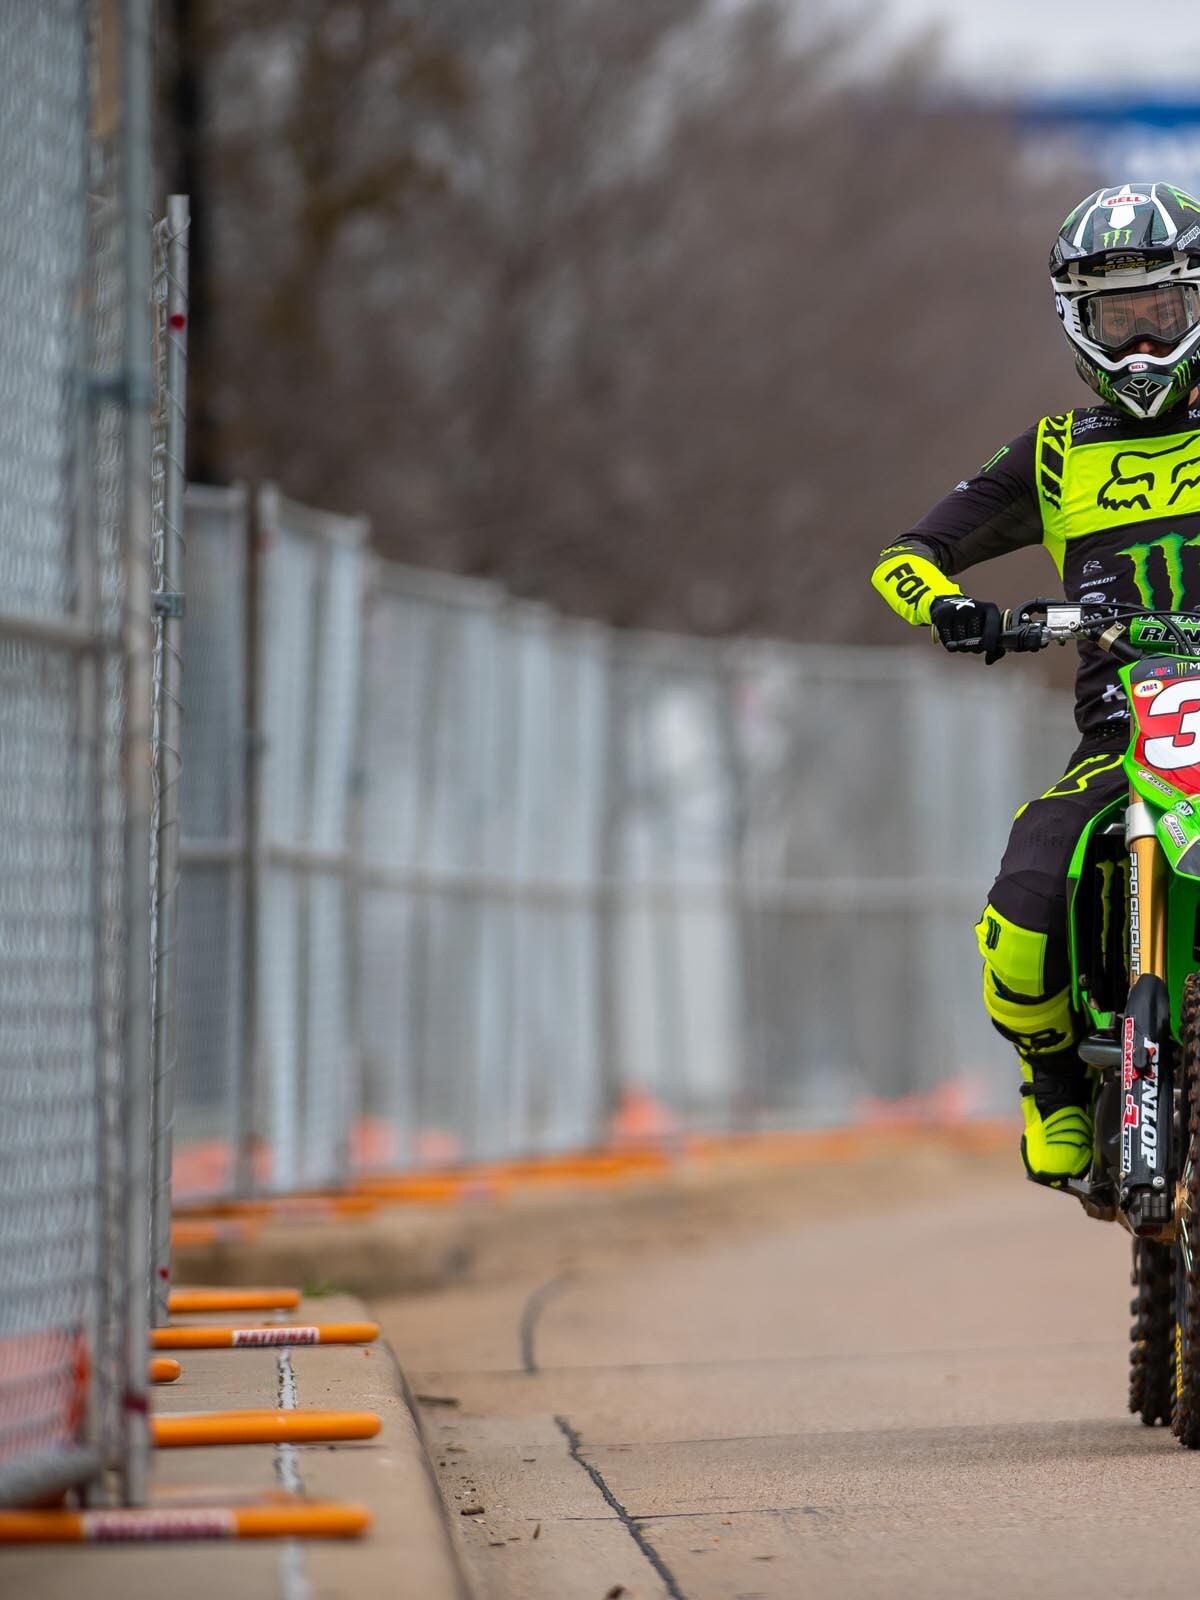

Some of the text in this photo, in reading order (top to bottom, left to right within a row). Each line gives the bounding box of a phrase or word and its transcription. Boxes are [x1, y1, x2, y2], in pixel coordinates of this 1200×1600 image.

[1107, 196, 1142, 206] BELL
[1092, 260, 1162, 273] PRO CIRCUIT
[1080, 576, 1118, 589] DUNLOP
[1129, 852, 1141, 977] PRO CIRCUIT
[1124, 1016, 1135, 1091] BRAKING
